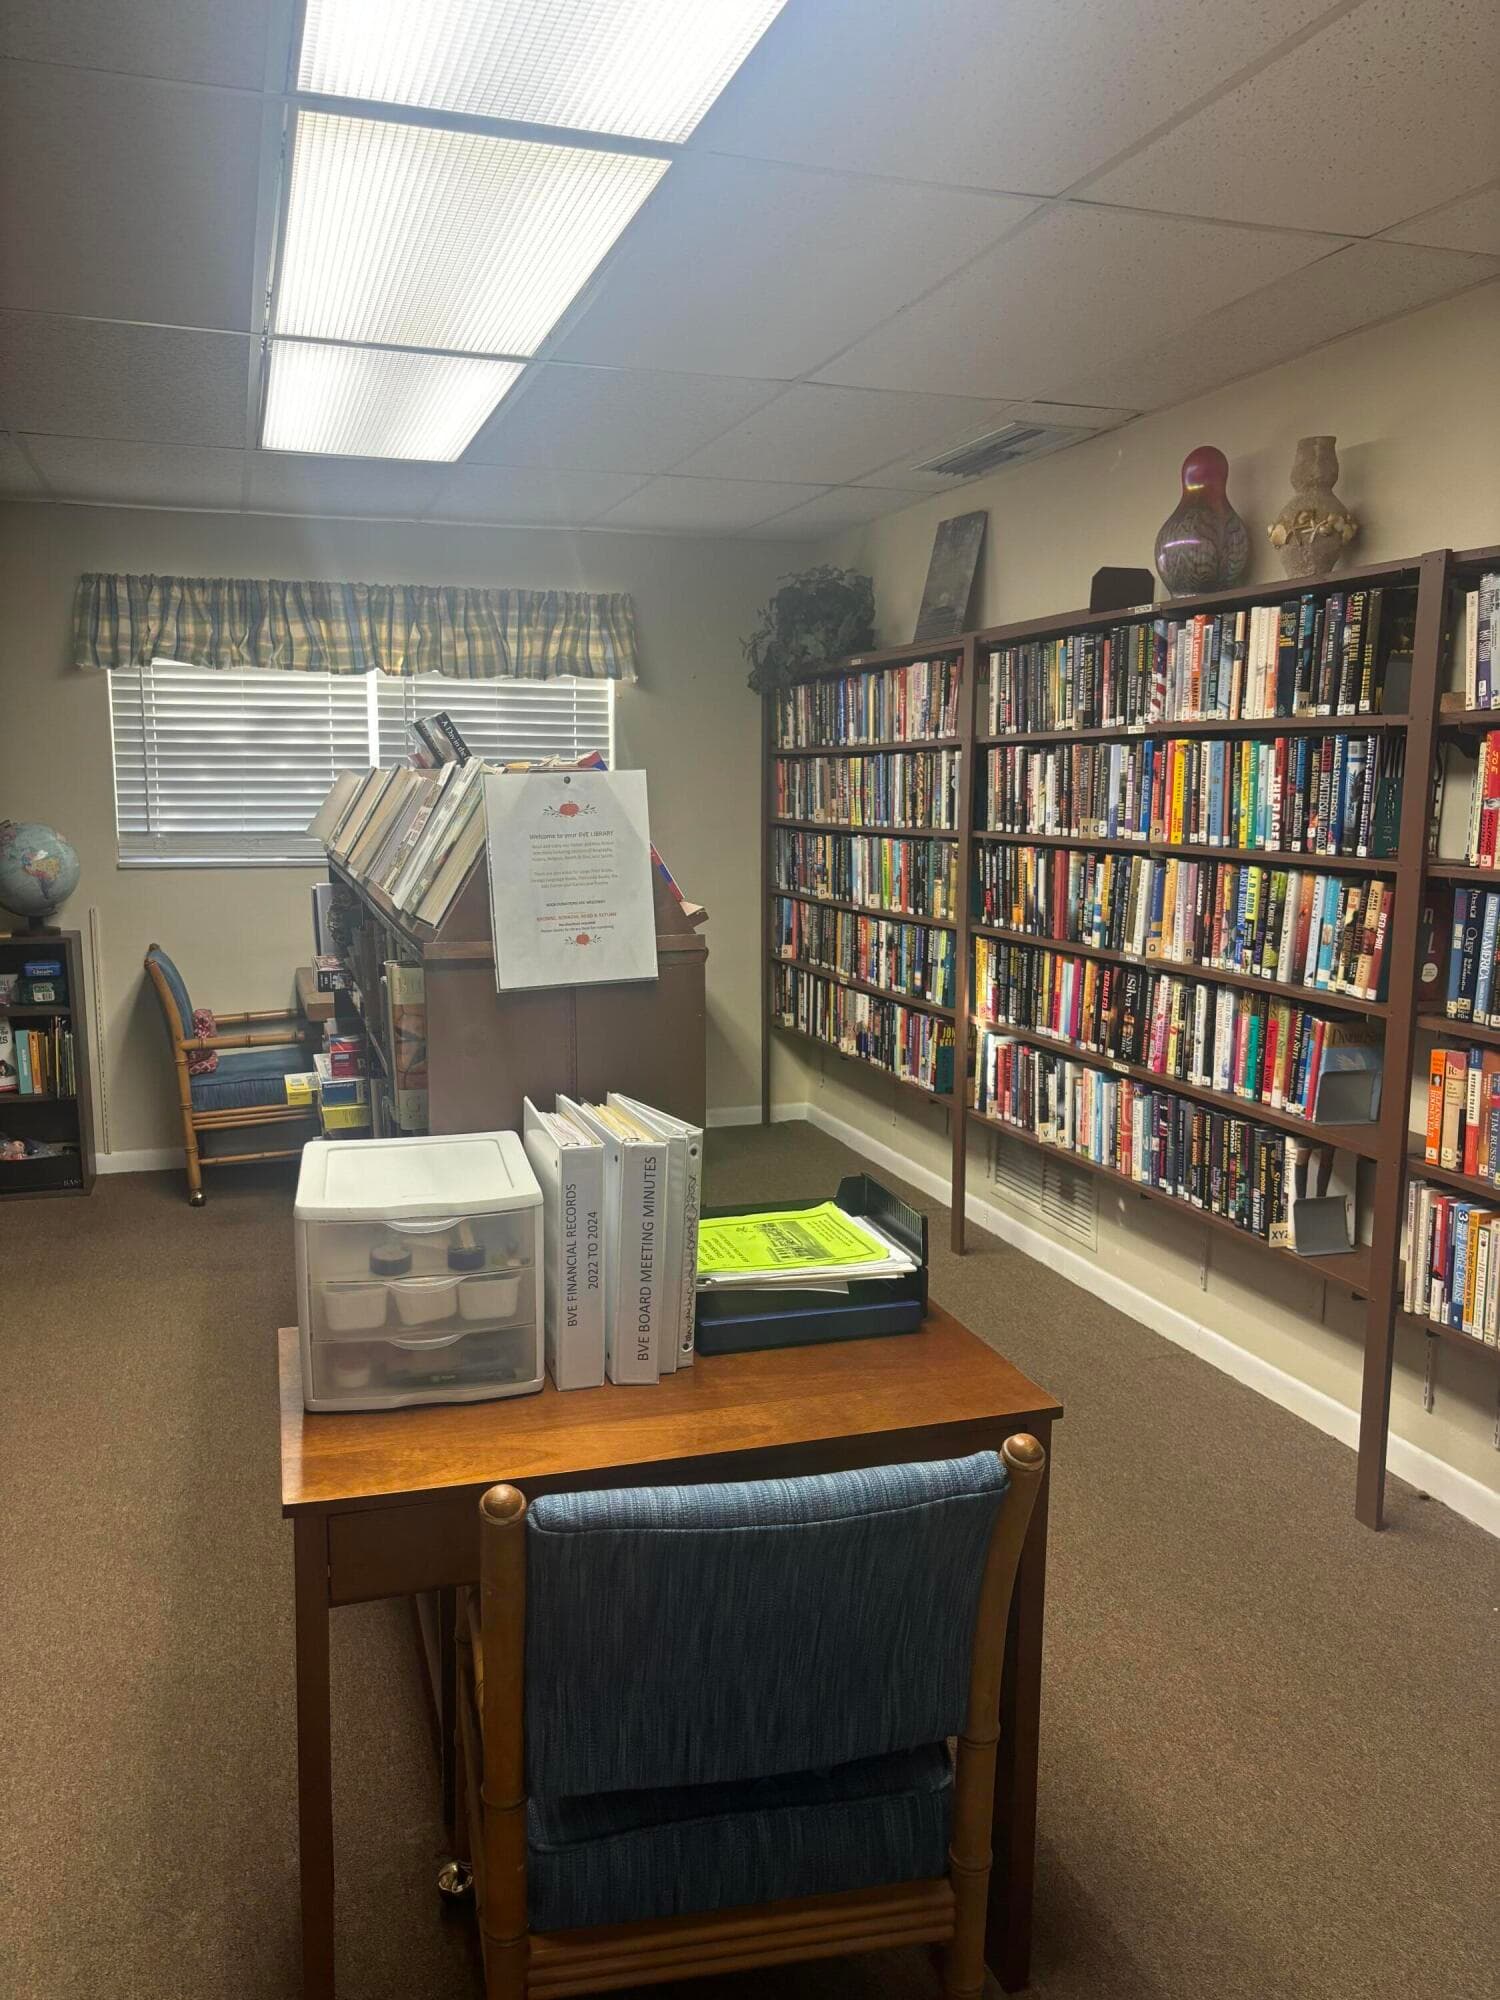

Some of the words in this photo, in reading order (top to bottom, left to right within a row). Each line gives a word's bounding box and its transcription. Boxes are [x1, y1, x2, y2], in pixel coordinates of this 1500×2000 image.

[1353, 596, 1364, 621] STEVE
[1299, 701, 1307, 709] M
[1334, 739, 1342, 769] JAMES
[1272, 776, 1281, 800] THE
[1330, 770, 1340, 824] PATTERSON
[1379, 912, 1387, 927] RED
[1375, 928, 1385, 950] APRIL
[1479, 937, 1492, 980] AMERICA
[1491, 1112, 1499, 1131] TIM
[644, 1156, 657, 1217] MINUTES
[567, 1184, 577, 1238] RECORDS
[1459, 1213, 1468, 1221] 3
[588, 1212, 599, 1242] 2024
[589, 1244, 598, 1260] TO
[640, 1220, 654, 1280] MEETING
[1456, 1242, 1468, 1269] JORGE
[568, 1239, 578, 1303] FINANCIAL
[589, 1263, 599, 1289] 2022
[1454, 1271, 1466, 1304] CRUISE
[568, 1306, 578, 1327] BVE
[639, 1284, 652, 1334] BOARD
[638, 1338, 649, 1361] BVE
